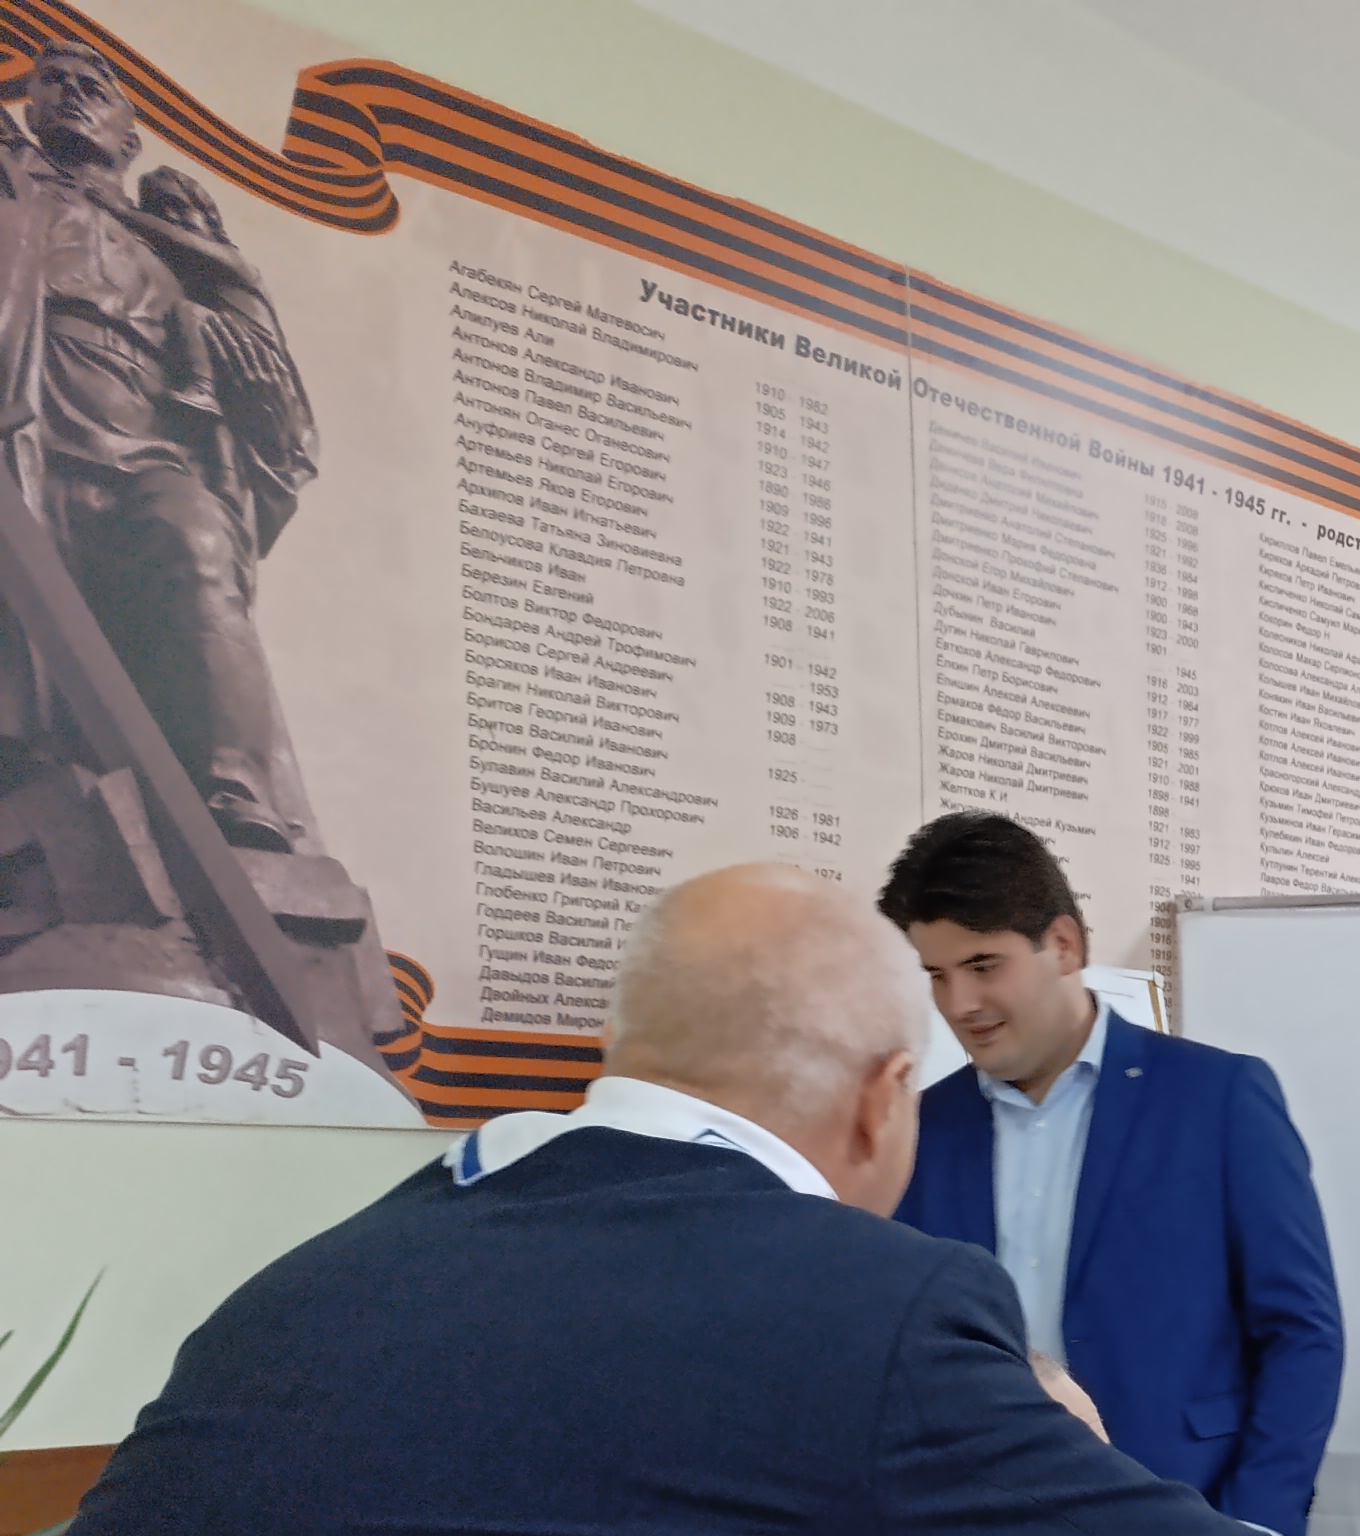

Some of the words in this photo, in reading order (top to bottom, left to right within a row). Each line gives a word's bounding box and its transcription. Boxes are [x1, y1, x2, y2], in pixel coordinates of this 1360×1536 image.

[527, 284, 582, 313] Сергей
[521, 304, 587, 336] Николай
[591, 325, 699, 372] Владимирович
[451, 325, 518, 357] Антонов
[521, 347, 605, 384] Александр
[609, 374, 679, 406] Иванович
[452, 368, 520, 400] Антонов
[524, 388, 572, 414] Павел
[576, 403, 664, 441] Васильевич
[639, 277, 785, 350] Участники
[794, 333, 902, 391] Великой
[912, 377, 1081, 452] Отечественной
[1087, 438, 1155, 478] Войны
[1162, 464, 1205, 495] 1941
[1224, 486, 1266, 516] 1945
[1270, 506, 1291, 526] гг.
[540, 435, 595, 461] Сергей
[599, 451, 666, 481] Егорович
[459, 519, 544, 553] Белоусова
[548, 541, 612, 568] Клавдия
[616, 557, 685, 587] Петровна
[523, 597, 578, 624] Виктор
[581, 612, 663, 640] Федорович
[463, 626, 531, 653] Борисов
[535, 641, 590, 665] Сергей
[592, 655, 673, 681] Андреевич
[525, 681, 591, 706] Николай
[595, 694, 679, 723] Викторович
[534, 786, 616, 813] Александр
[620, 799, 704, 824] Прохорович
[539, 766, 605, 788] Василий
[608, 778, 718, 807] Александрович
[472, 839, 545, 861] Волошин
[549, 850, 588, 867] Иван
[592, 855, 661, 876] Петрович
[475, 880, 548, 903] Глобенко
[552, 890, 620, 911] Григорий
[477, 923, 544, 943] Горшков
[547, 930, 612, 949] Василий
[117, 1056, 137, 1067] -
[161, 1039, 310, 1100] 1945
